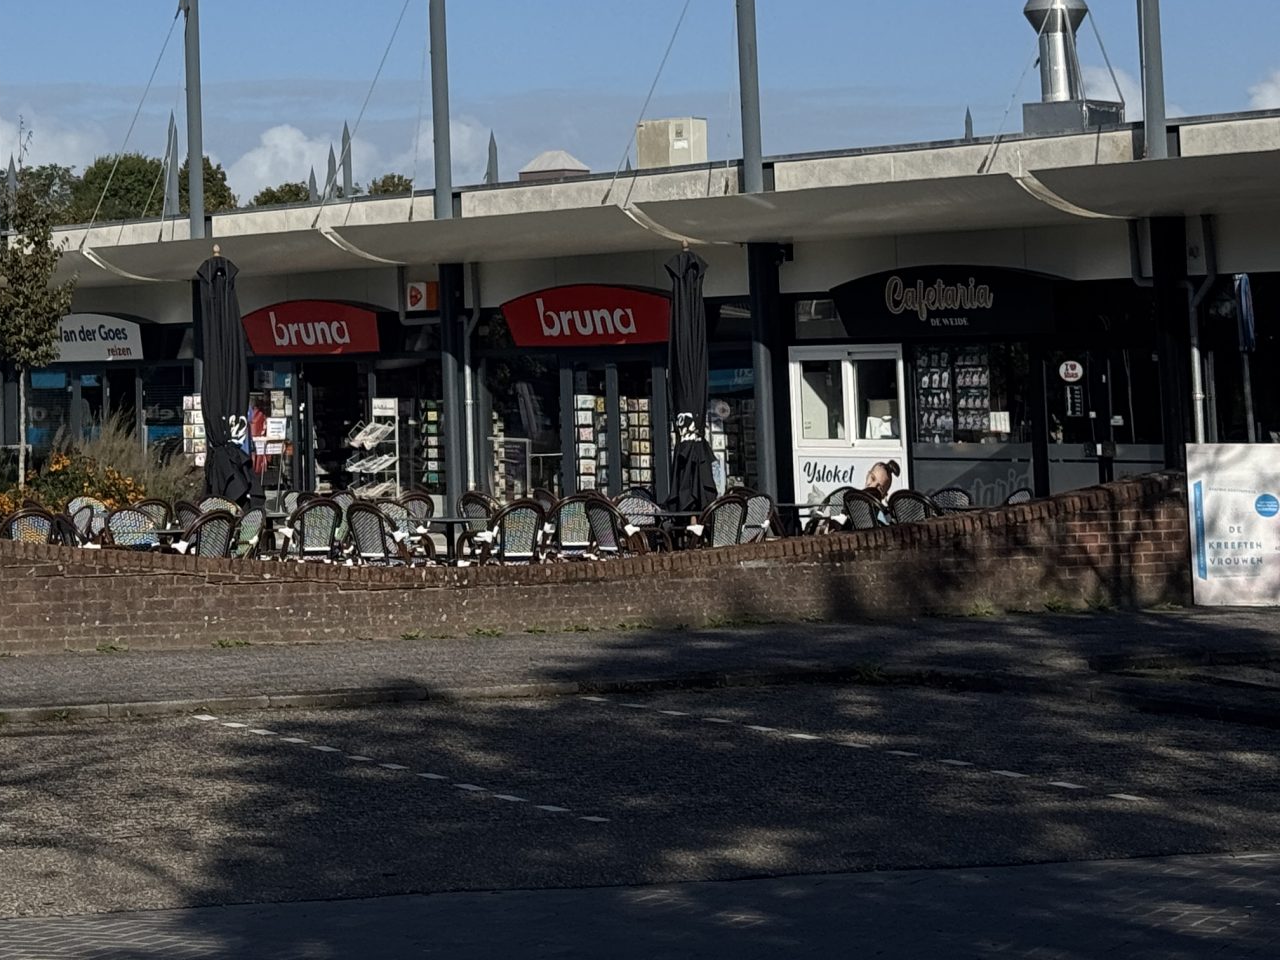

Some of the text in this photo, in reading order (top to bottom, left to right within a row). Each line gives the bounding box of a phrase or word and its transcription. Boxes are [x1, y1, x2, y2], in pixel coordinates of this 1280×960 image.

[885, 275, 994, 321] Cafetaria
[535, 297, 637, 337] bruna
[930, 317, 969, 326] DE WEIDE
[78, 325, 97, 342] der
[98, 324, 128, 341] Goes
[268, 311, 351, 346] bruna
[107, 345, 132, 356] reizen
[1208, 542, 1262, 550] KREEFTEN
[1210, 557, 1263, 566] VROUWEN
